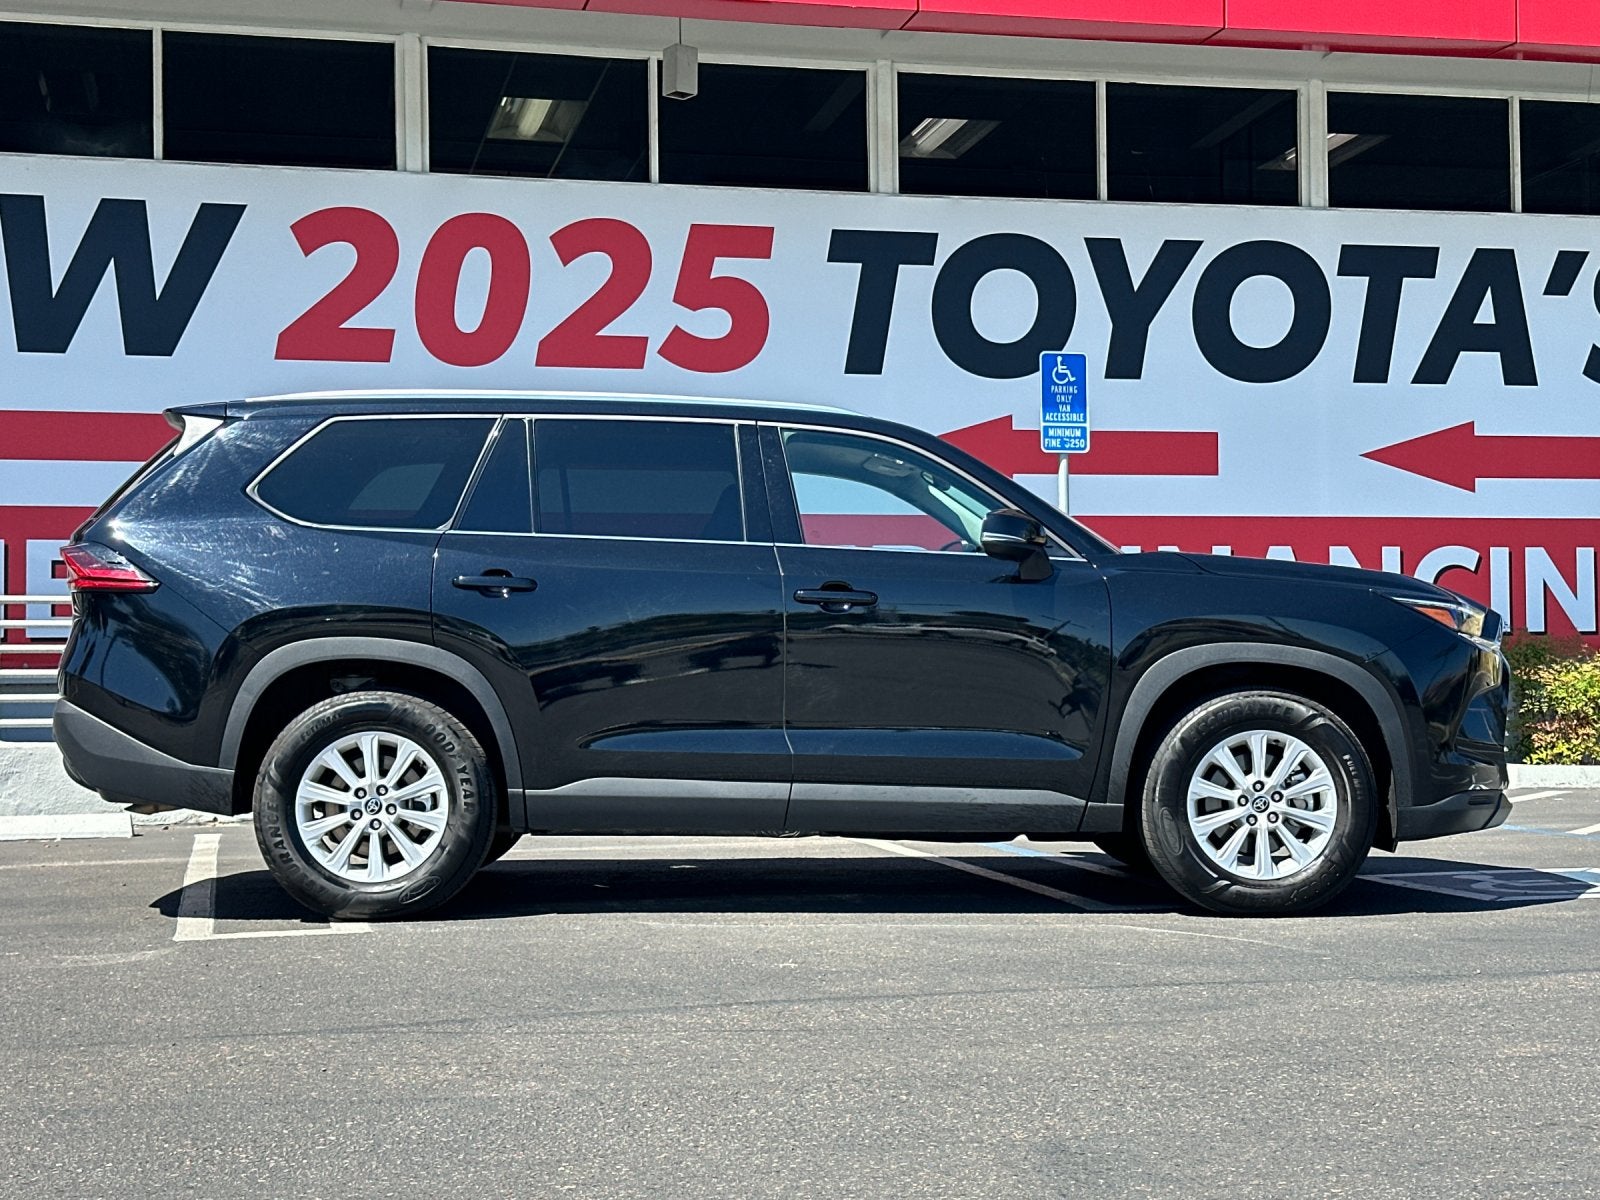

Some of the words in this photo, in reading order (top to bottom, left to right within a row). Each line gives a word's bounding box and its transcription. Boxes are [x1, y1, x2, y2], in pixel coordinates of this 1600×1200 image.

[274, 206, 775, 374] 2025
[826, 228, 1600, 387] TOYOTA'
[1051, 385, 1078, 394] PARKING
[1056, 395, 1073, 403] ONLY
[1059, 404, 1071, 412] VAN
[1045, 413, 1085, 422] ACCESSIBLE
[1048, 428, 1082, 437] MINIMUM
[1044, 438, 1061, 447] FINE
